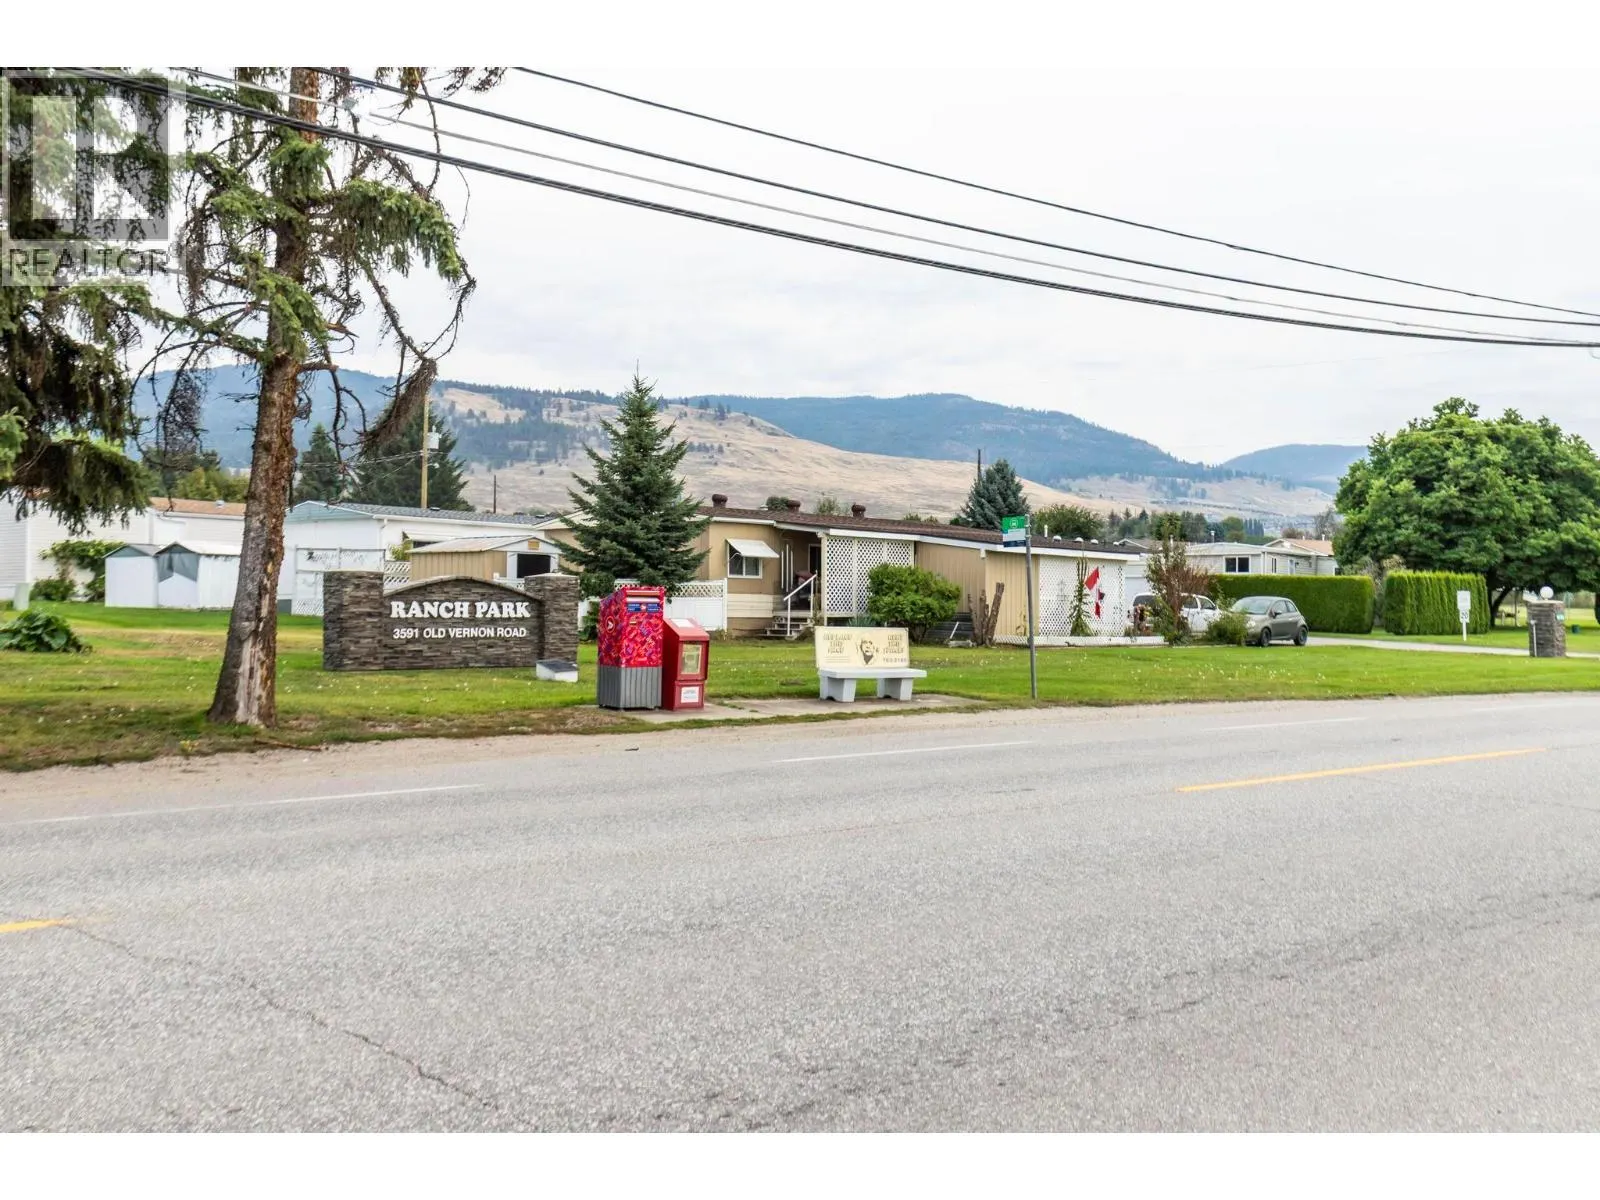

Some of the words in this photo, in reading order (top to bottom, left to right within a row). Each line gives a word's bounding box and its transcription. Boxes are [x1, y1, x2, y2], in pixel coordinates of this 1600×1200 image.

[390, 601, 469, 619] RANCH
[475, 601, 531, 618] PARK
[393, 628, 419, 639] 3591
[423, 628, 446, 638] OLD
[449, 627, 495, 638] VERNON
[497, 627, 527, 638] ROAD
